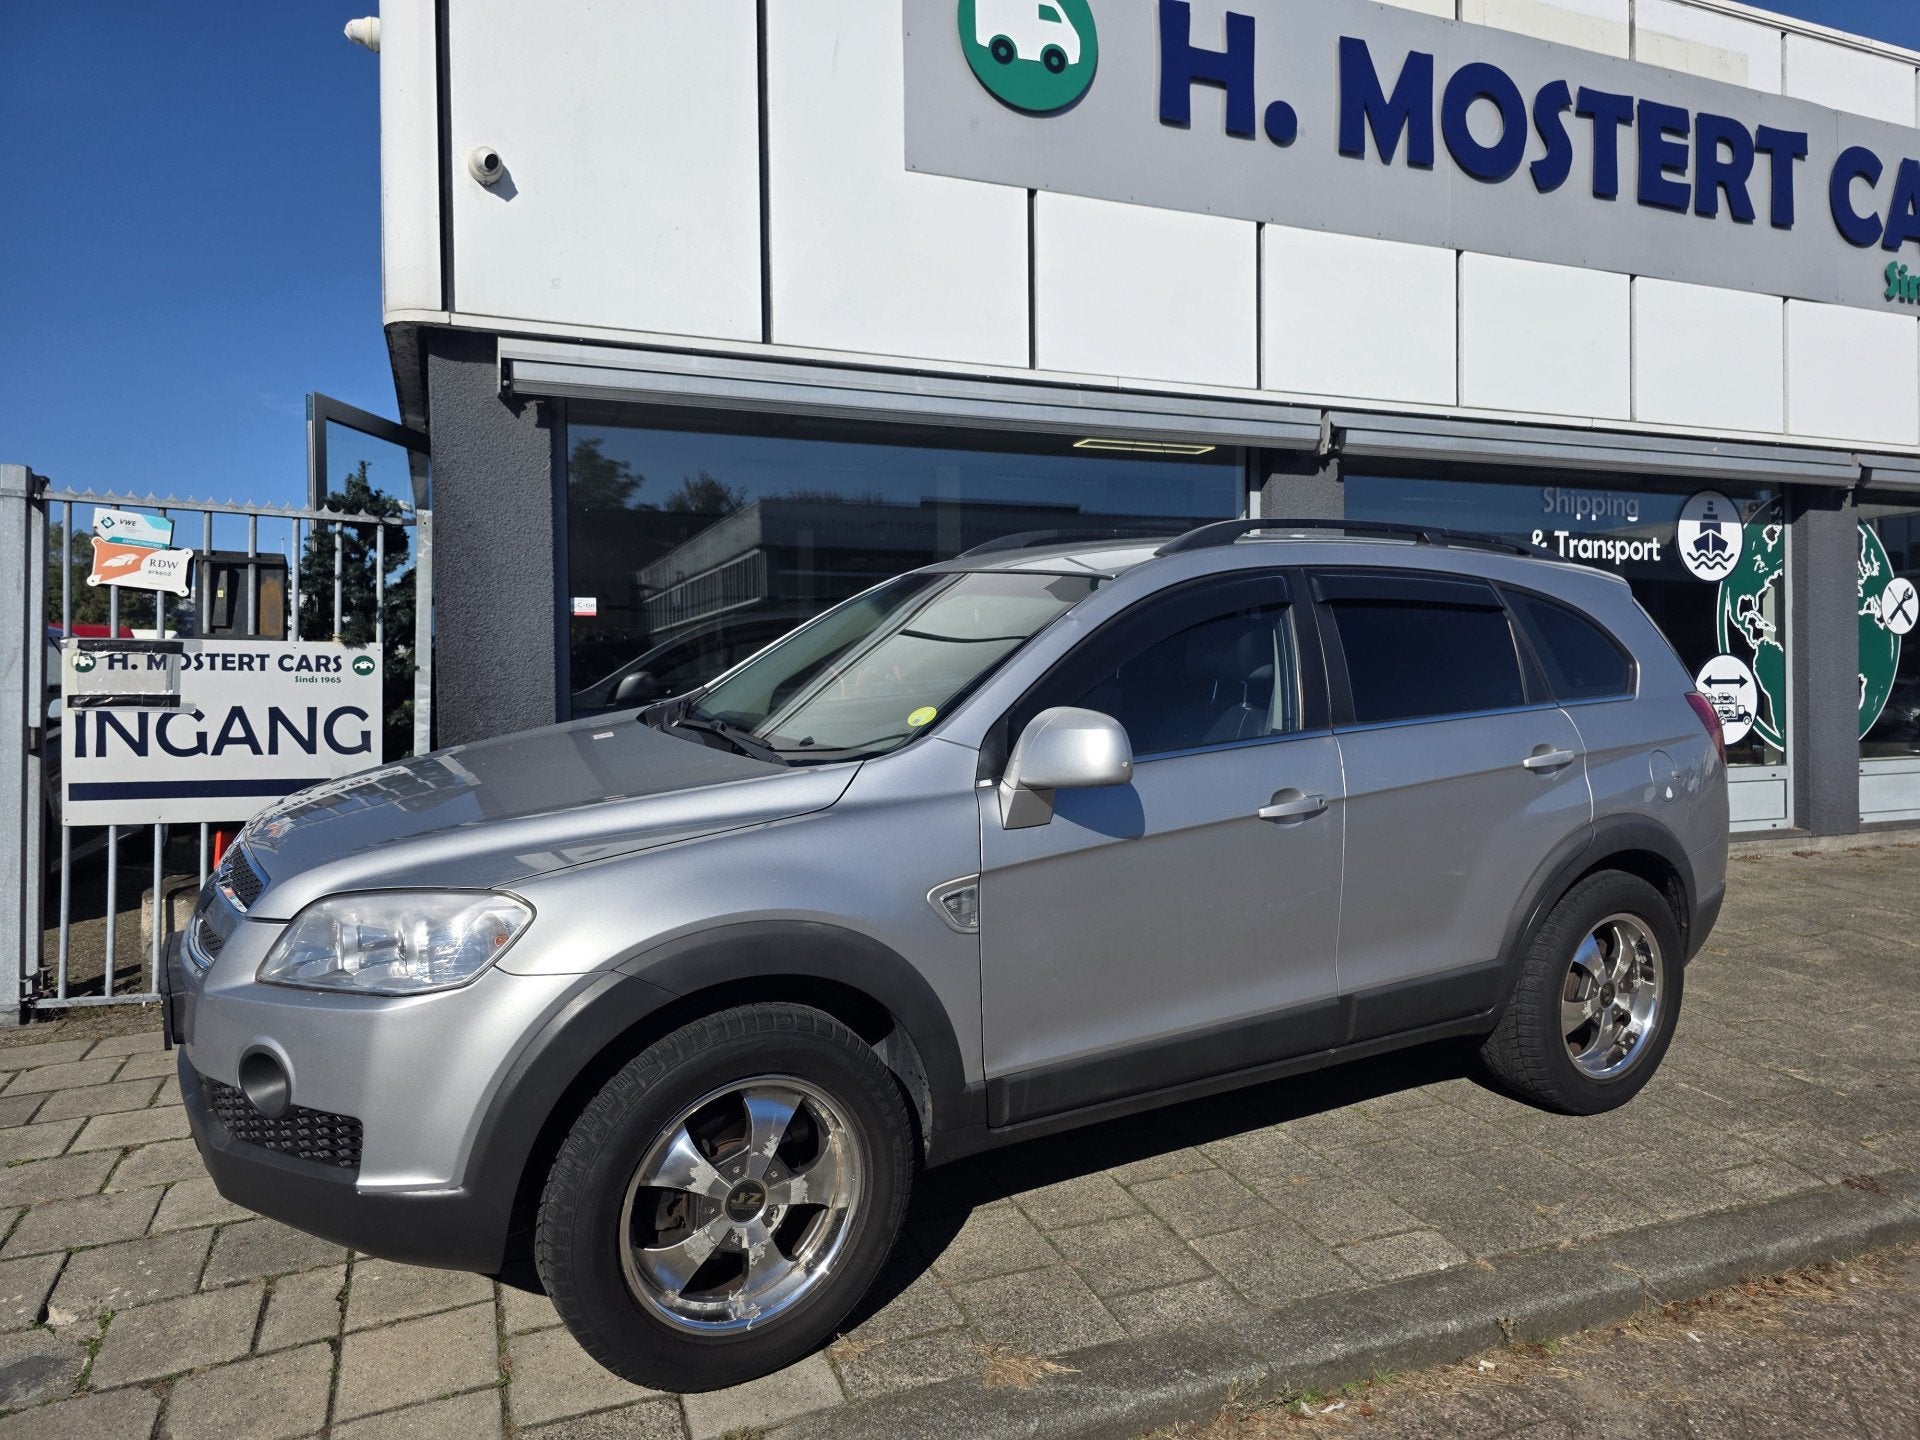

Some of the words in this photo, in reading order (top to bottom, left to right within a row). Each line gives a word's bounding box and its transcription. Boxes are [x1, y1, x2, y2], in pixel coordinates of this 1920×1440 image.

[1158, 0, 1298, 148] H.
[1337, 36, 1808, 230] MOSTERT
[1543, 486, 1639, 522] Shipping
[119, 518, 137, 527] VWE
[1554, 530, 1661, 565] Transport
[147, 569, 172, 577] erkend
[149, 558, 179, 570] RDW
[107, 652, 138, 671] H.
[277, 653, 342, 673] CARS
[294, 675, 318, 684] Sinds
[320, 675, 342, 684] 1965
[75, 705, 372, 758] INGANG
